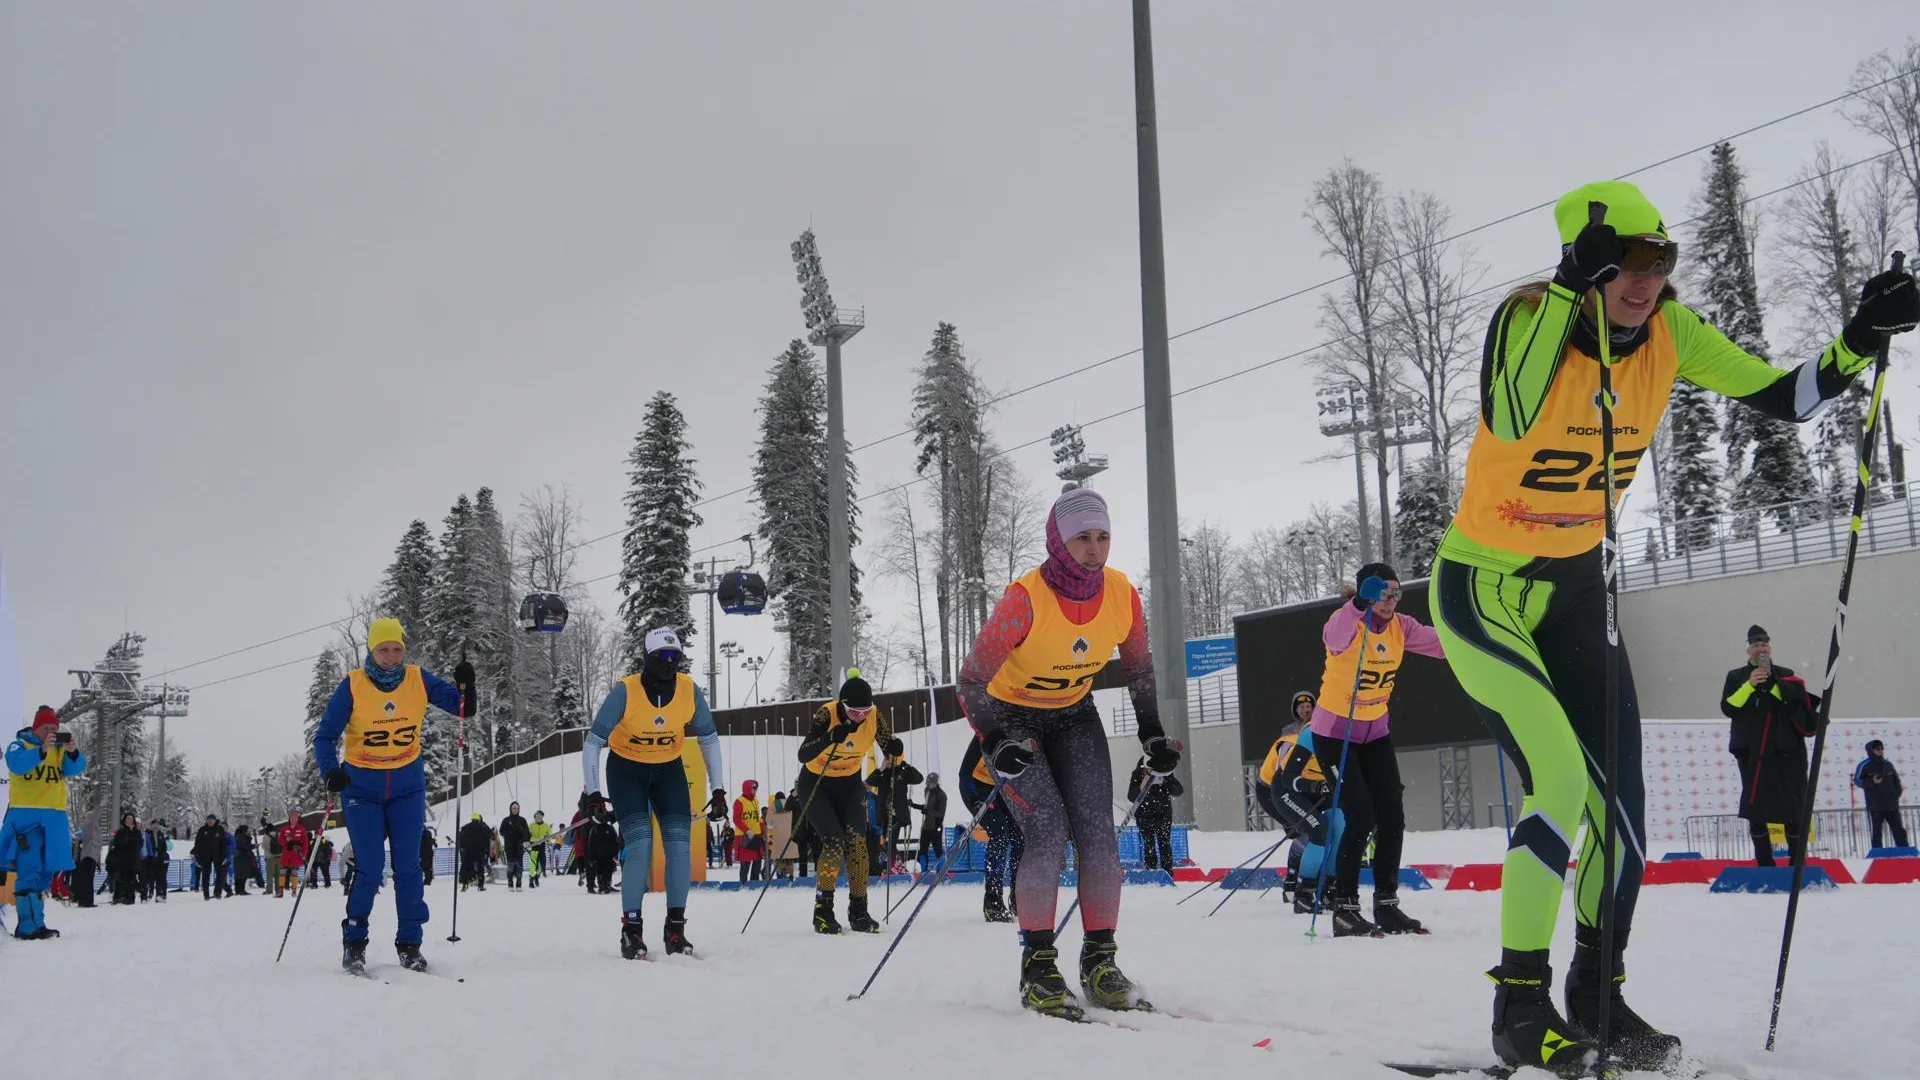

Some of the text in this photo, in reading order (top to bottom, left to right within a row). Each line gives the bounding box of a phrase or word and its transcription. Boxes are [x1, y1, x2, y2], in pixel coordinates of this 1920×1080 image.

[1567, 426, 1639, 436] РОСНФТЬ
[1520, 447, 1648, 493] 22
[1607, 595, 1615, 637] SPORT
[1052, 661, 1102, 671] РОСНЕФТЬ
[363, 725, 416, 747] 23
[1503, 977, 1543, 986] FISCHER
